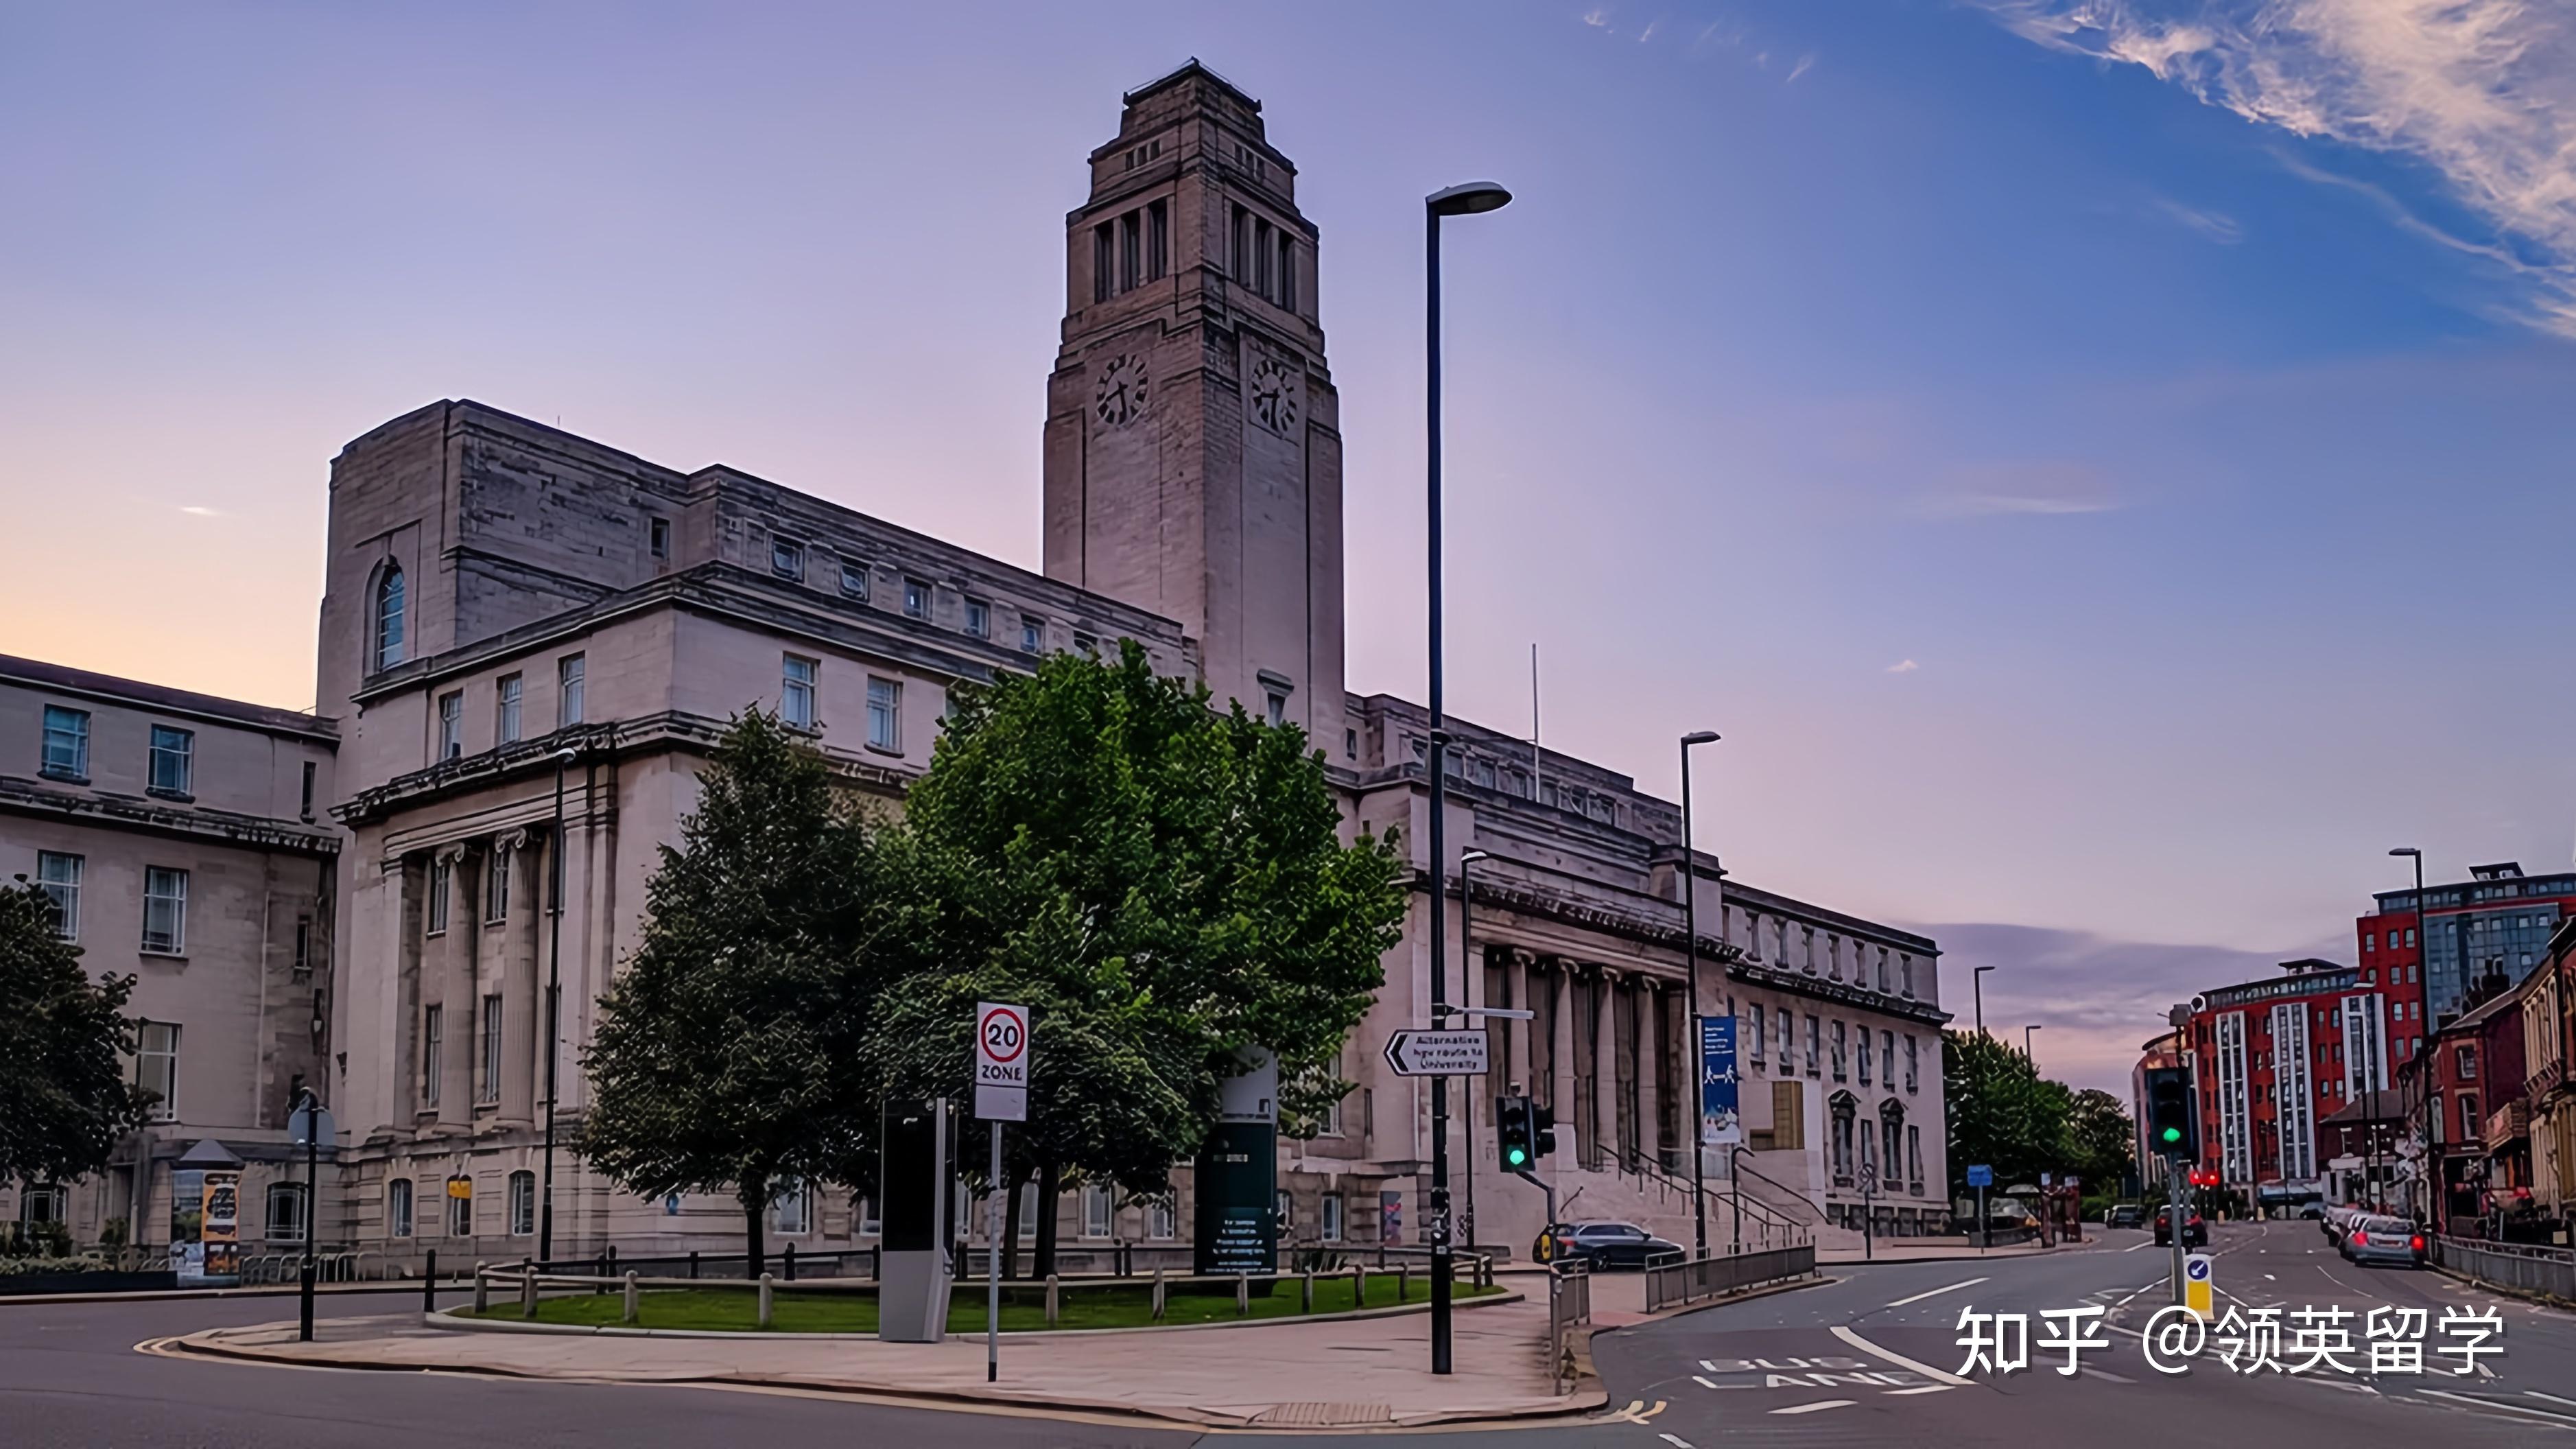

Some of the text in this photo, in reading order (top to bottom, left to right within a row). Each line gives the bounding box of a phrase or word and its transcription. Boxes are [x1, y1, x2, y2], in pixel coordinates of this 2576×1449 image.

[988, 1024, 1019, 1048] 20
[1416, 1036, 1480, 1045] Alternative
[1420, 1058, 1478, 1070] University
[982, 1064, 1023, 1081] ZONE
